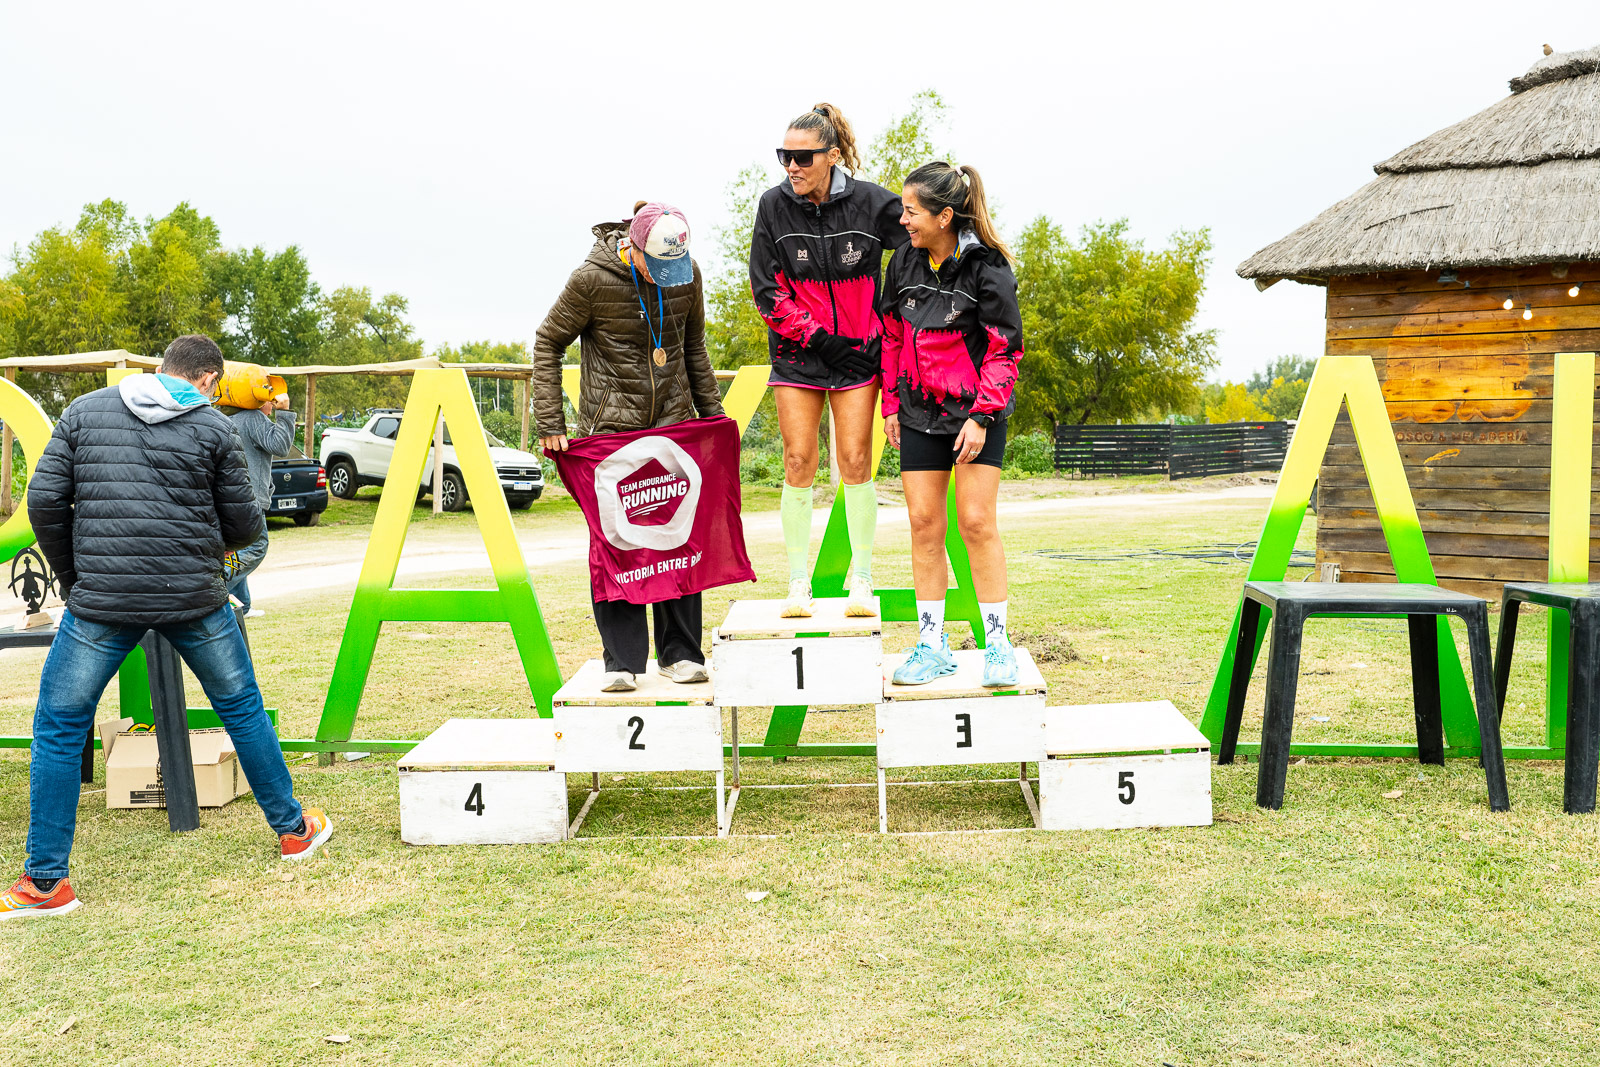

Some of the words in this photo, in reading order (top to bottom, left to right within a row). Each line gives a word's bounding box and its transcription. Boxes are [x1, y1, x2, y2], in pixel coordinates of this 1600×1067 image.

[620, 481, 638, 494] TEAM
[638, 472, 677, 489] ENDURANCE
[622, 480, 687, 510] RUNNING
[614, 564, 655, 584] VICTORIA
[657, 557, 688, 574] ENTRE
[792, 647, 805, 690] 1
[627, 716, 646, 751] 2
[955, 713, 972, 748] 3
[464, 782, 485, 816] 4
[1117, 772, 1136, 805] 5
